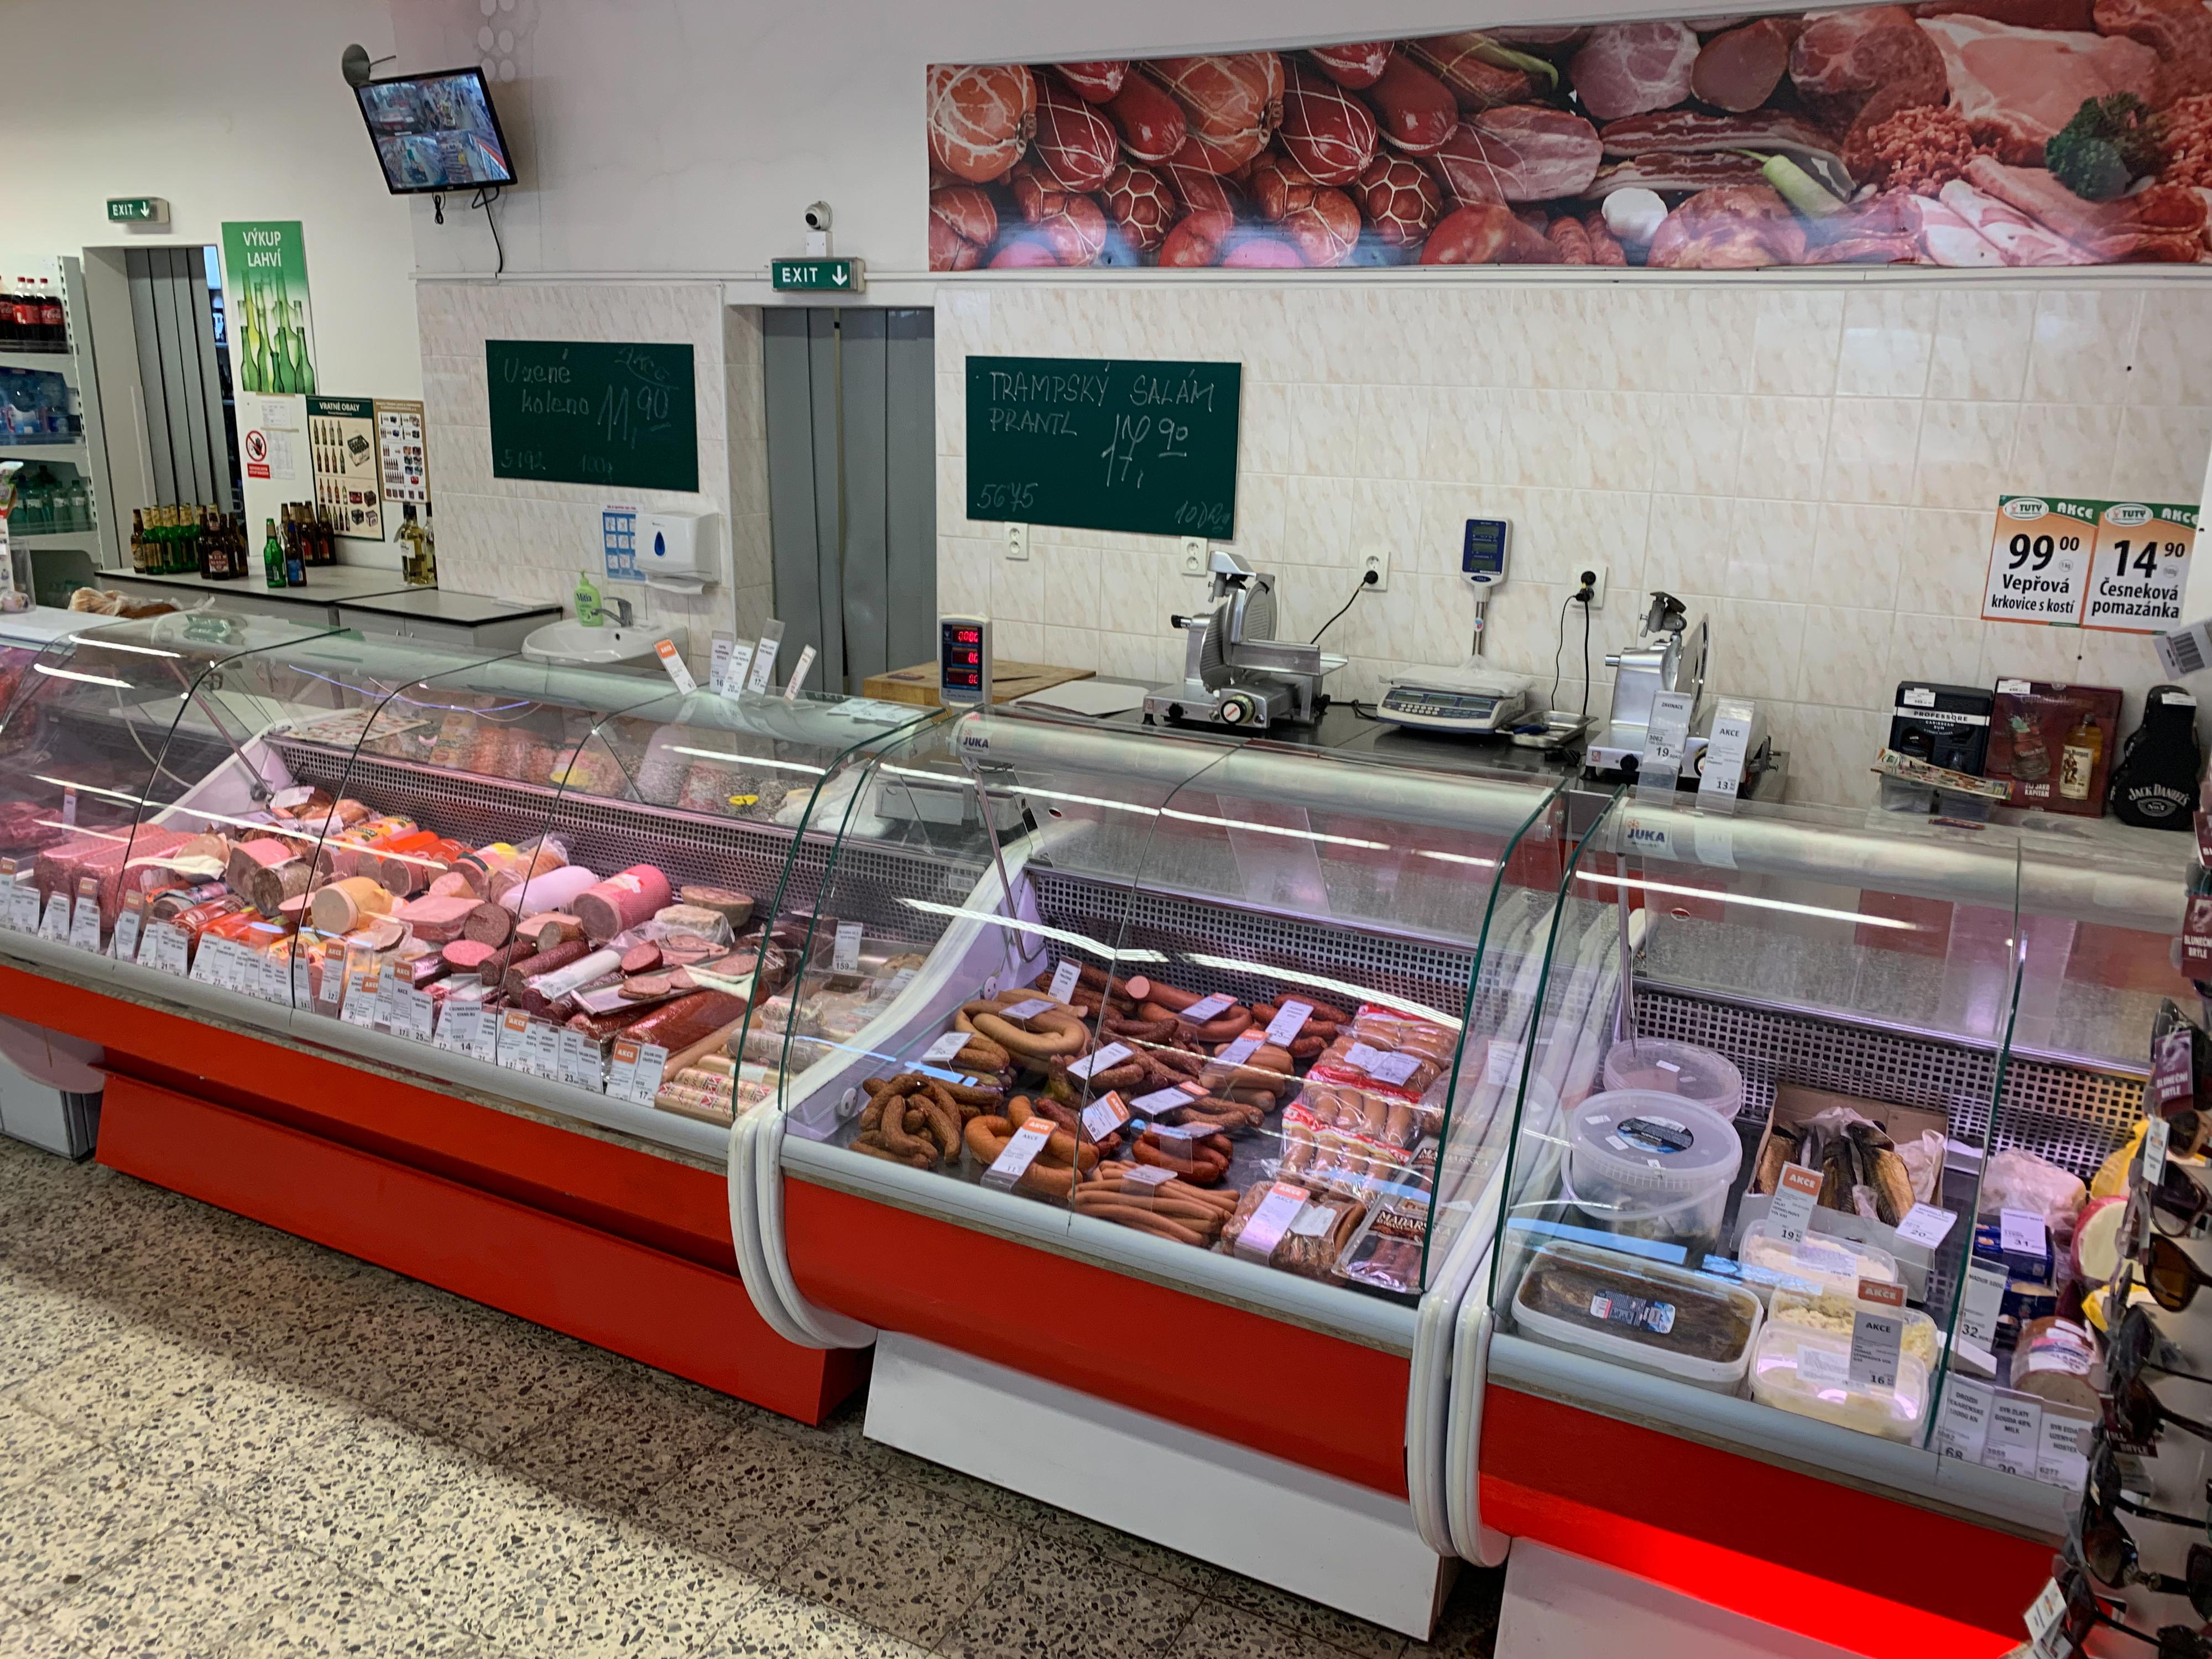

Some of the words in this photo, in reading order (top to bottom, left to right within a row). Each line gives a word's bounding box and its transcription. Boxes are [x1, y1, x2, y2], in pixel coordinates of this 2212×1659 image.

[112, 204, 133, 216] EXIT
[243, 227, 281, 247] VÝKUP
[247, 248, 282, 267] LAHVÍ
[781, 267, 818, 283] EXIT
[989, 362, 1110, 407] TRAMPSKÝ
[1130, 369, 1214, 412] SALÁM
[319, 401, 341, 410] VRATNÉ
[342, 404, 360, 412] OBALY
[989, 407, 1077, 436] PRANTL
[2019, 503, 2042, 513] TUTY
[2057, 502, 2094, 519] AKCE
[2121, 509, 2146, 518] TUTY
[2008, 533, 2055, 572] 99
[2059, 536, 2080, 552] 00
[2114, 539, 2158, 579] 14
[2164, 542, 2186, 558] 90
[2003, 573, 2070, 594] Vepřová
[2100, 577, 2179, 601] Česneková
[1991, 594, 2037, 611] krkovice
[2039, 602, 2044, 611] s
[2047, 598, 2075, 614] kostí
[2091, 601, 2180, 619] pomazánka
[1913, 710, 1969, 722] PROFESSORE
[1719, 727, 1740, 738] AKCE
[963, 736, 989, 748] JUKA
[1656, 747, 1669, 758] 19
[1716, 780, 1728, 790] 13
[2128, 786, 2152, 801] JACK
[1627, 828, 1666, 843] JUKA
[2184, 934, 2212, 948] SLUNEČN
[836, 962, 849, 971] 159
[508, 1018, 525, 1027] AKCE
[415, 1031, 424, 1041] 25
[461, 1042, 471, 1051] 14
[617, 1048, 634, 1058] AKCE
[565, 1073, 573, 1083] 23
[639, 1090, 648, 1099] 17
[1788, 1173, 1816, 1189] AKCE
[1781, 1229, 1794, 1240] 19
[1910, 1229, 1926, 1238] 20
[1865, 1287, 1896, 1300] AKCE
[1865, 1322, 1891, 1333] AKCE
[1961, 1324, 1979, 1338] 32
[1870, 1374, 1885, 1385] 16
[1955, 1391, 1979, 1405] DROZDI
[1994, 1414, 2016, 1425] GOUDA
[2063, 1425, 2078, 1434] EIDA
